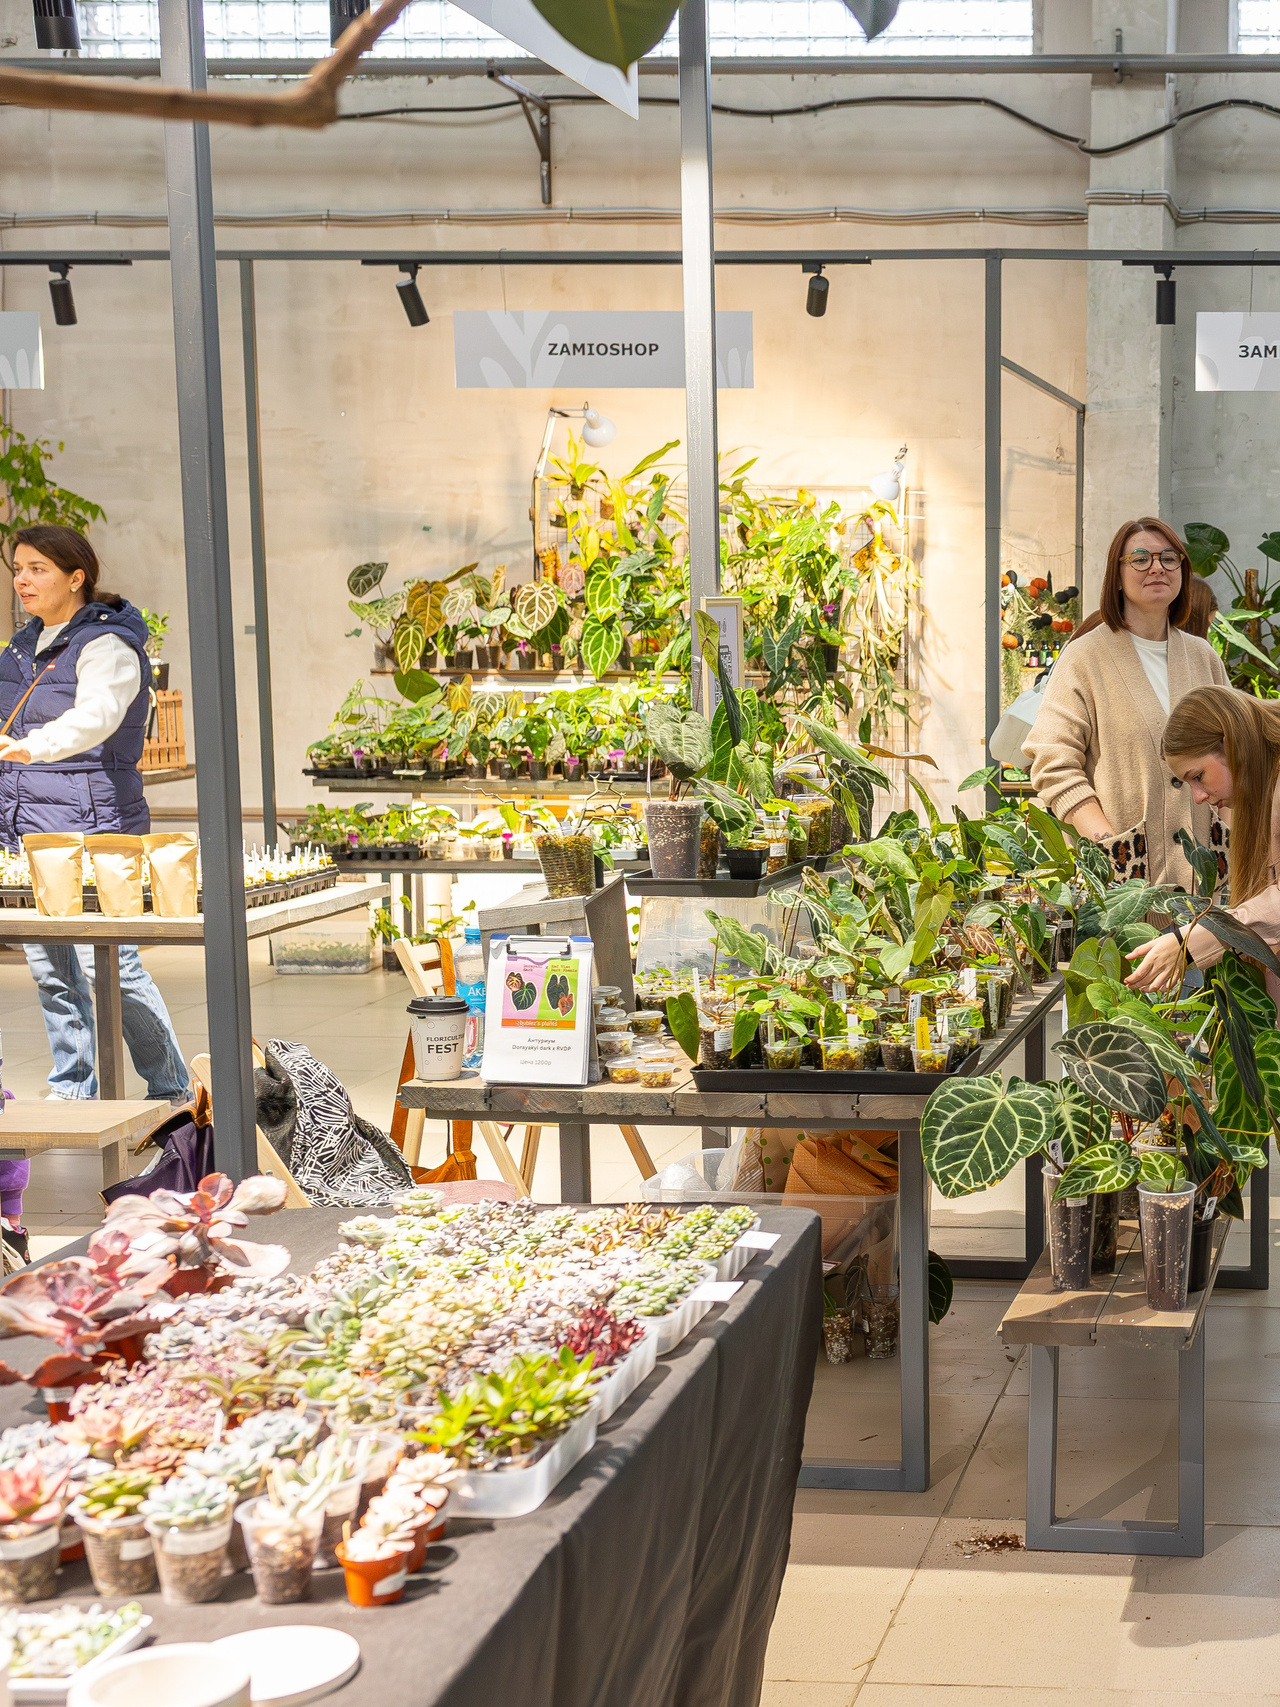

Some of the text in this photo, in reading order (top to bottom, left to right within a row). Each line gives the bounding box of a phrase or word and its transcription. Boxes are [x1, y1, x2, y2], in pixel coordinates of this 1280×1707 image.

[548, 343, 659, 356] ZAMIOSHOP
[527, 1037, 556, 1045] Антуриум
[427, 1042, 459, 1054] FEST
